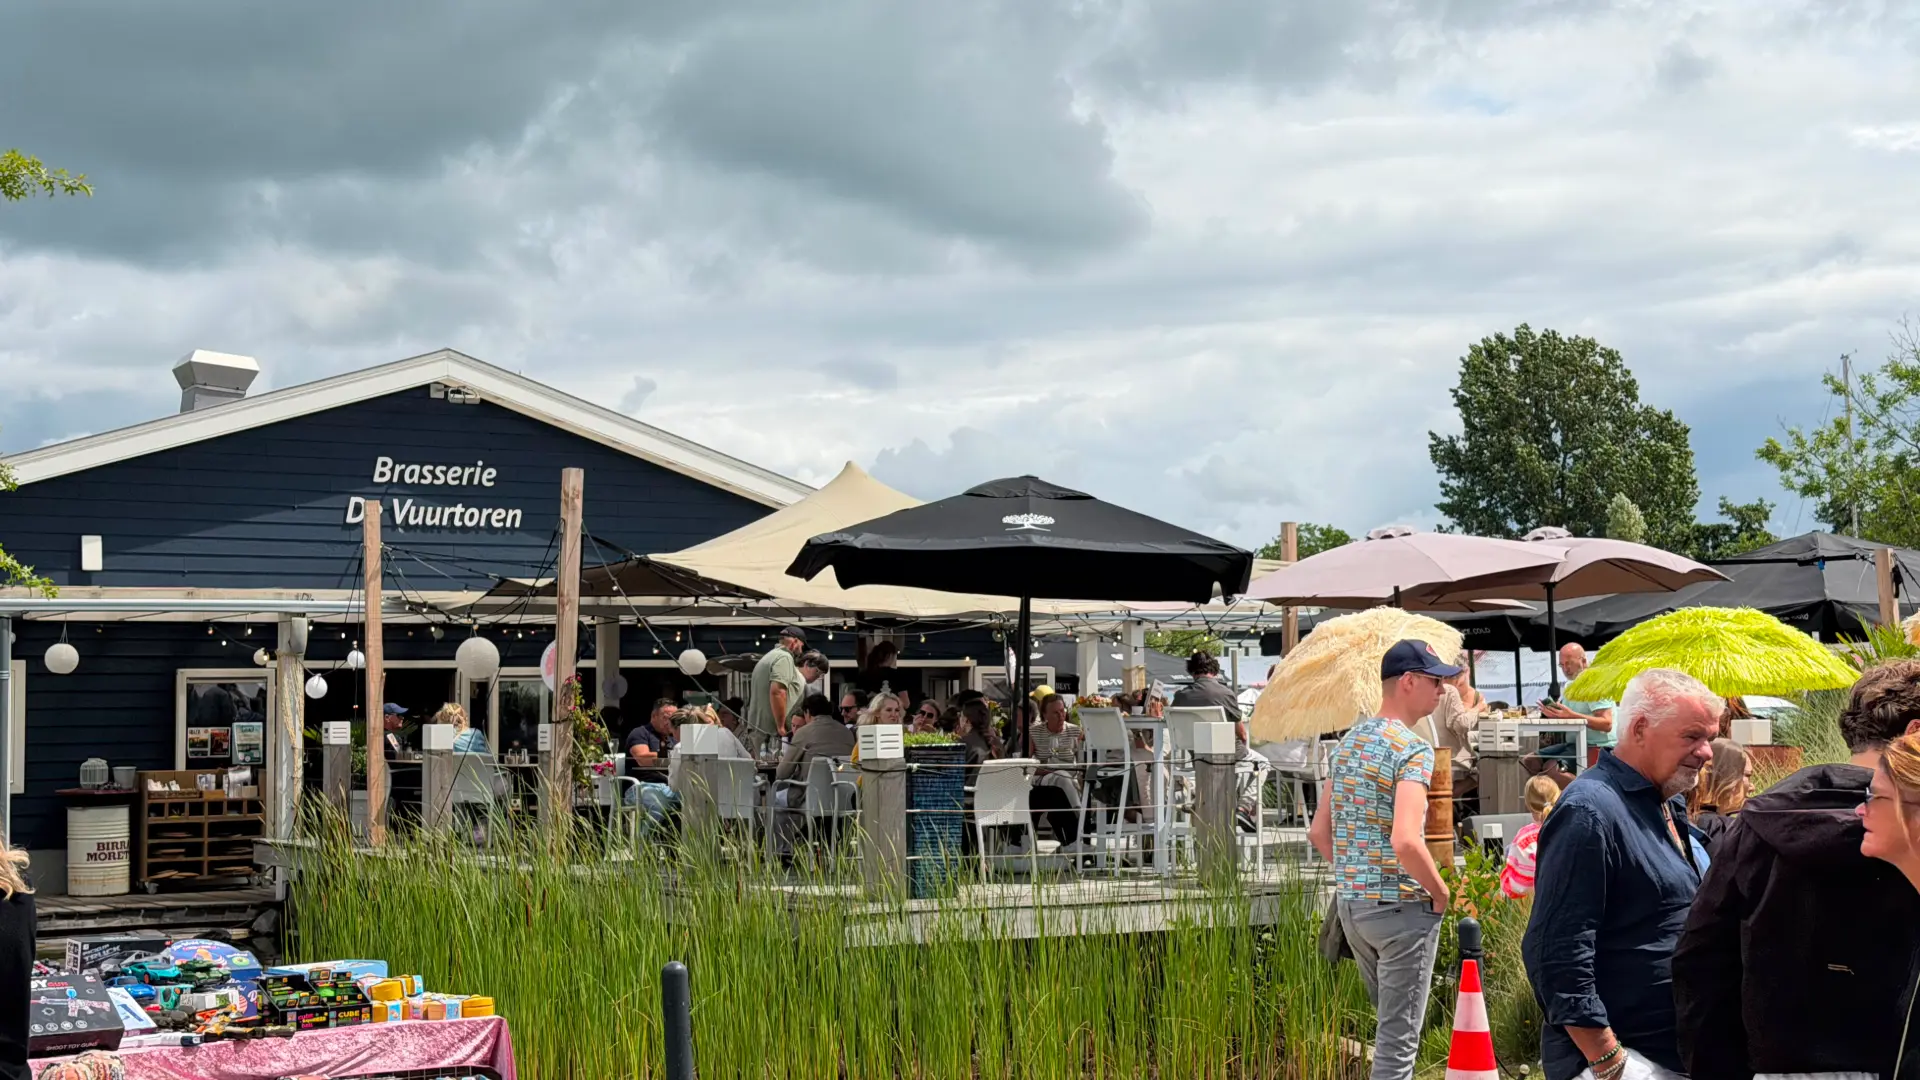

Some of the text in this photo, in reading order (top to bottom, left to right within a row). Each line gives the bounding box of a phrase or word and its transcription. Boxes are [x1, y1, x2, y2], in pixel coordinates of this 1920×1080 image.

[373, 456, 497, 487] Brasserie
[346, 496, 522, 528] D Vuurtoren
[83, 945, 121, 962] TRUCK
[338, 1010, 360, 1018] CUBE
